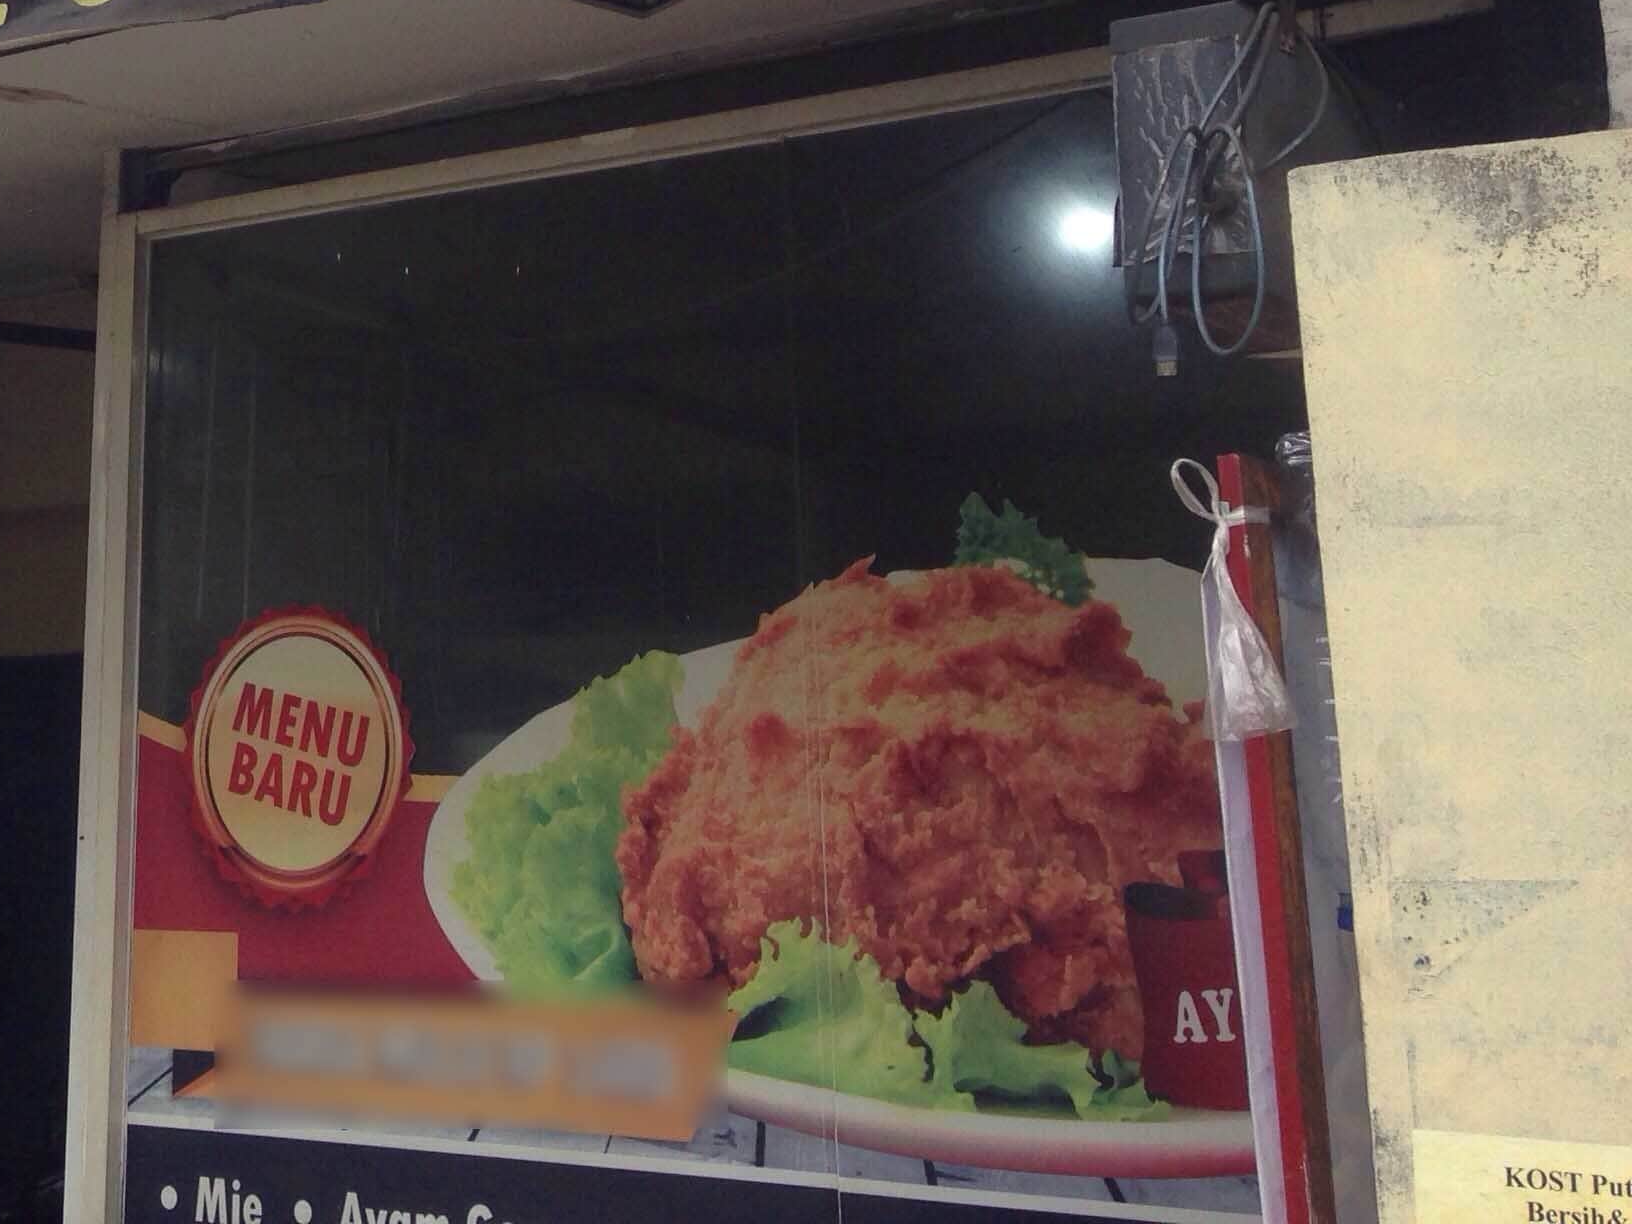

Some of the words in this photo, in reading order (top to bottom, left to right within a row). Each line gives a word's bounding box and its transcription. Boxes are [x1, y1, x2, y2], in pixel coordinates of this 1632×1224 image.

[231, 681, 371, 767] MENU
[227, 741, 352, 827] BARU
[1173, 987, 1236, 1045] AY
[195, 1176, 263, 1224] Mie
[1504, 1166, 1583, 1193] KOST
